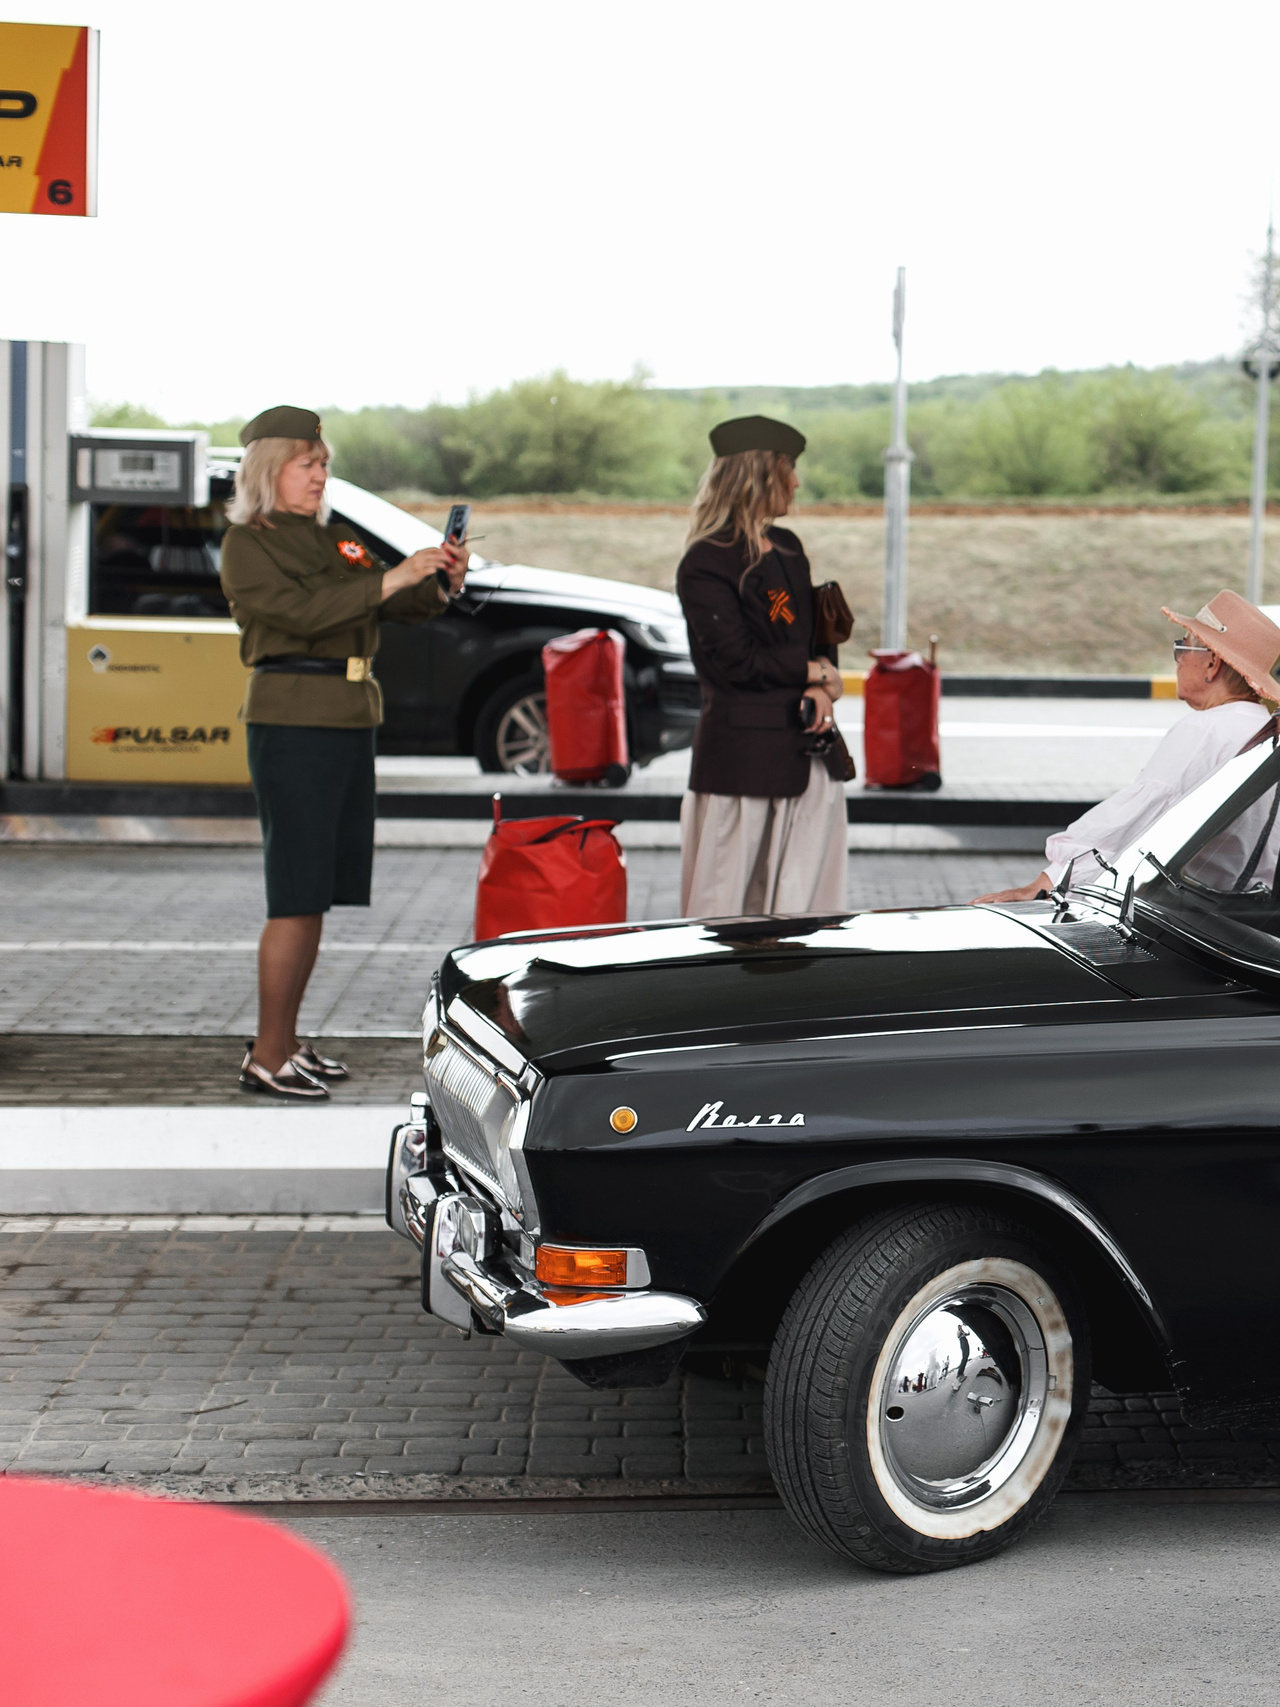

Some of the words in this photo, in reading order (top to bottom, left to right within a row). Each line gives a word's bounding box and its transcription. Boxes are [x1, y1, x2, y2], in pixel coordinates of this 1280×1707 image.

[47, 178, 74, 206] 6
[113, 726, 231, 744] PULSAR
[685, 1100, 806, 1133] Волга
